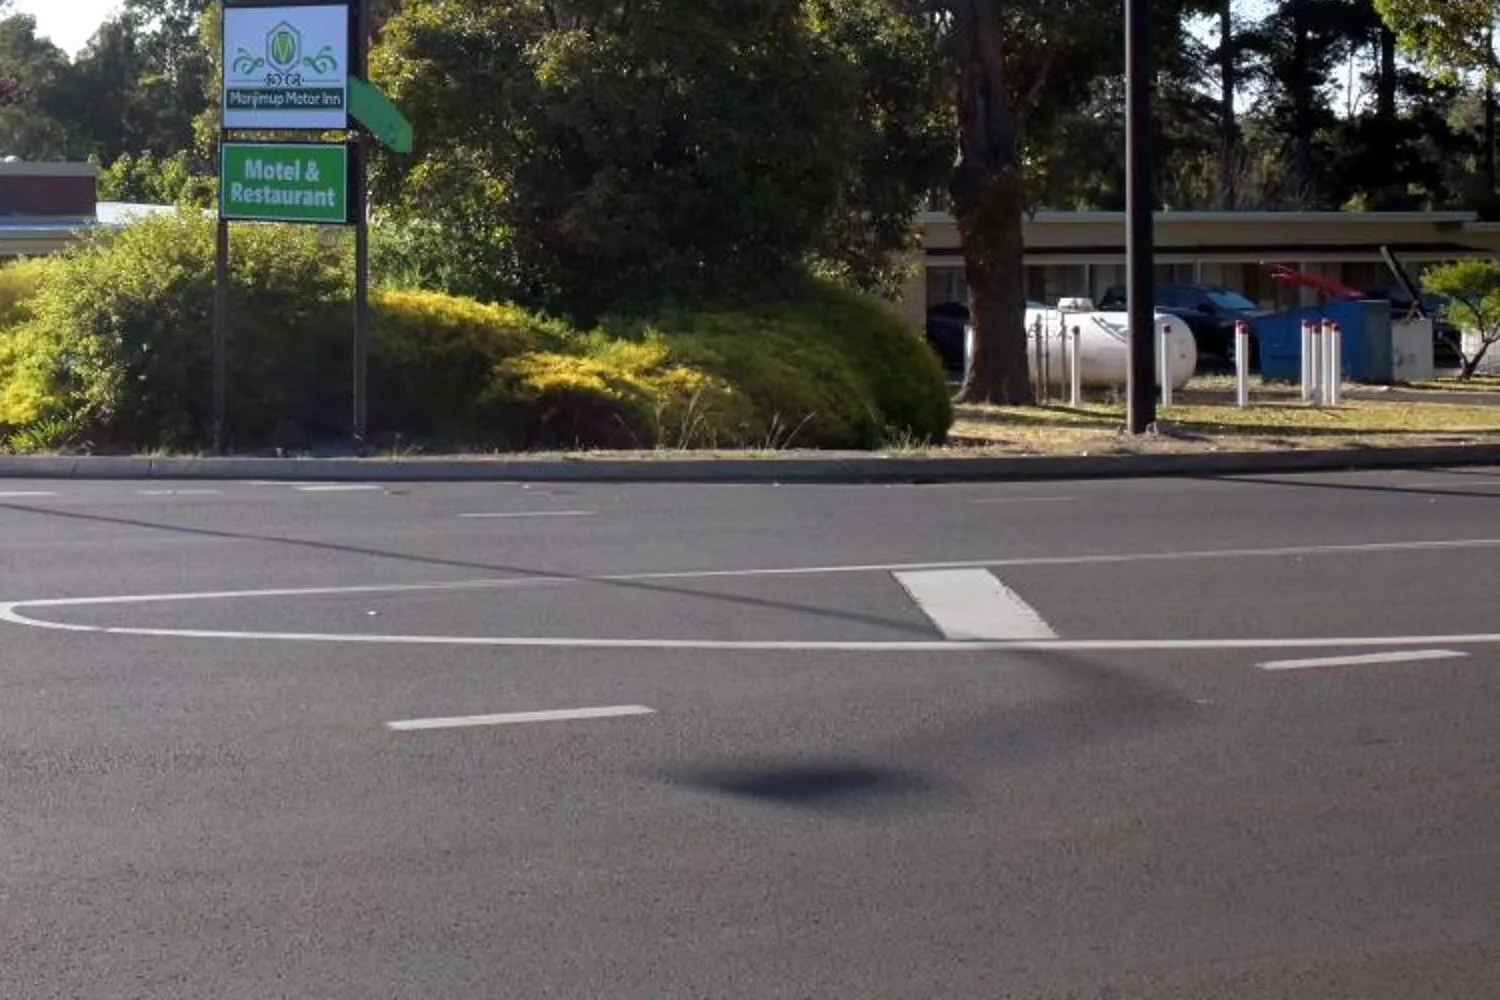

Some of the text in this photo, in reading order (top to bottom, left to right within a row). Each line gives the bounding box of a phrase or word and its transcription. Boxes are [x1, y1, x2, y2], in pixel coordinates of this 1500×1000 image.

[286, 91, 320, 105] Motor
[322, 91, 341, 105] Inn
[245, 158, 320, 182] Motel &
[231, 181, 336, 208] Restaurant
